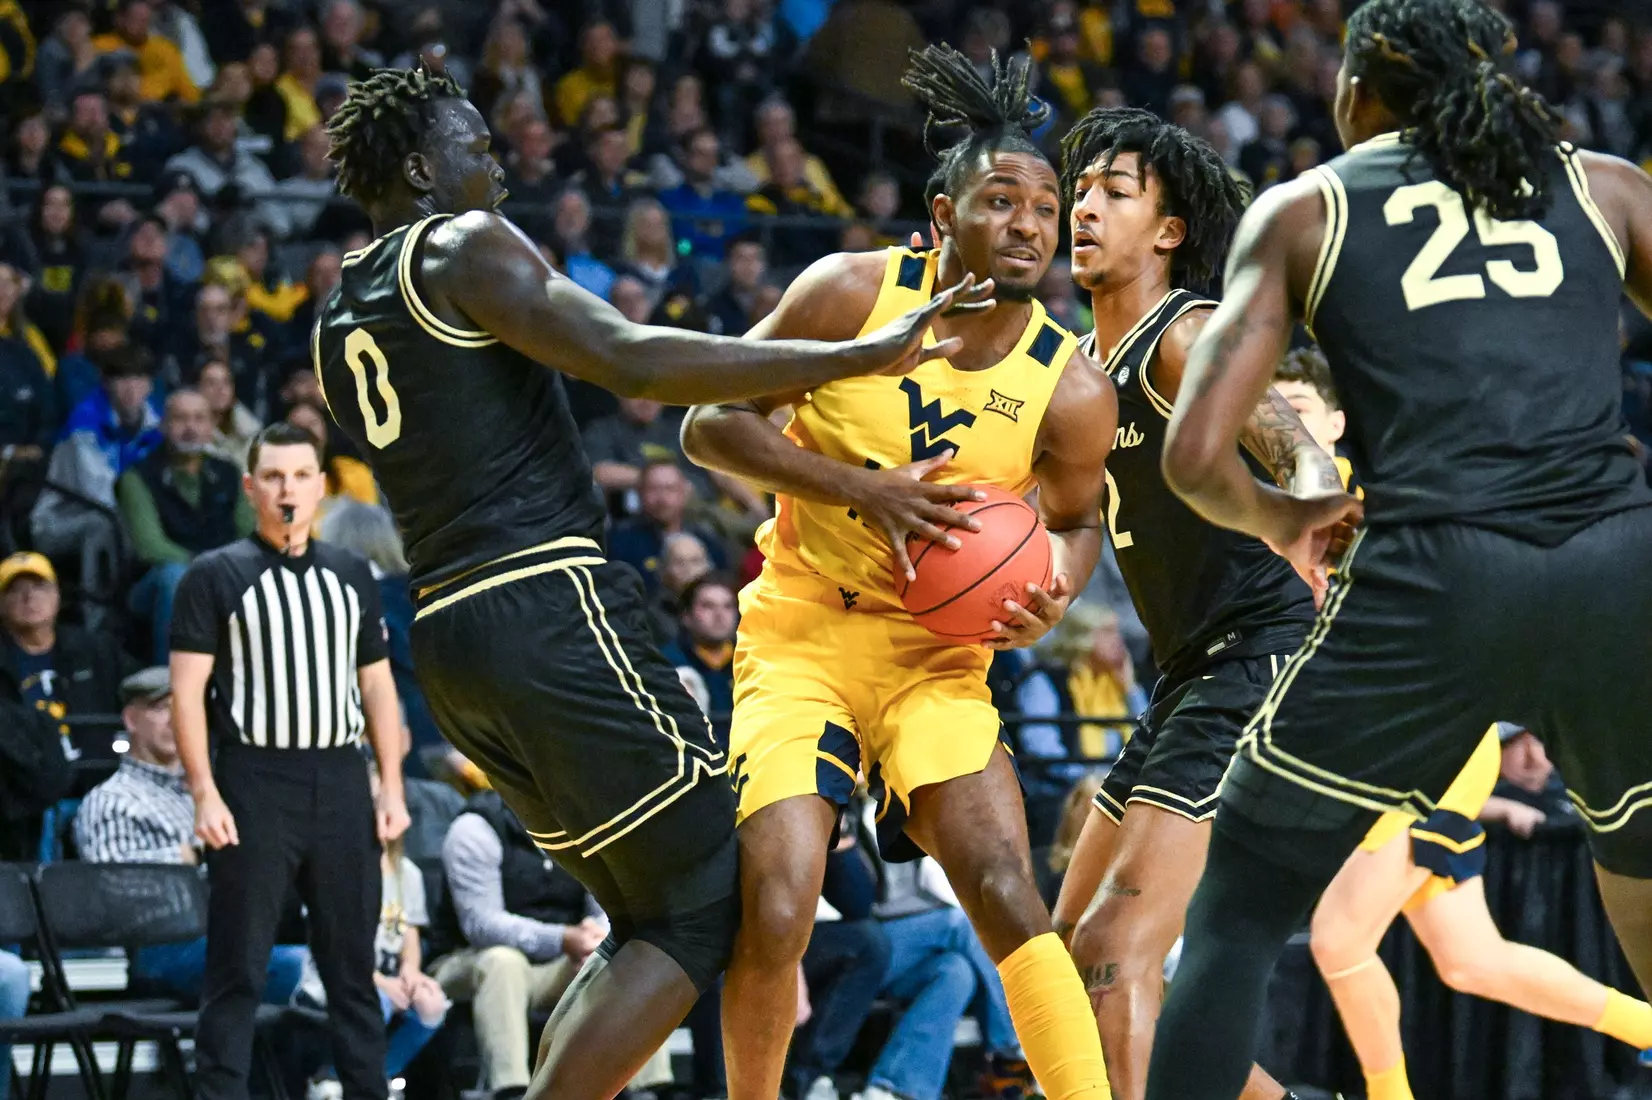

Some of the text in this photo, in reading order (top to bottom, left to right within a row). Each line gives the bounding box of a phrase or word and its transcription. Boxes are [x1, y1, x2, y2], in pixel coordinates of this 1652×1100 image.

[1383, 180, 1564, 311] 25
[344, 327, 402, 450] 0
[983, 389, 1025, 422] XII
[1227, 631, 1236, 641] M
